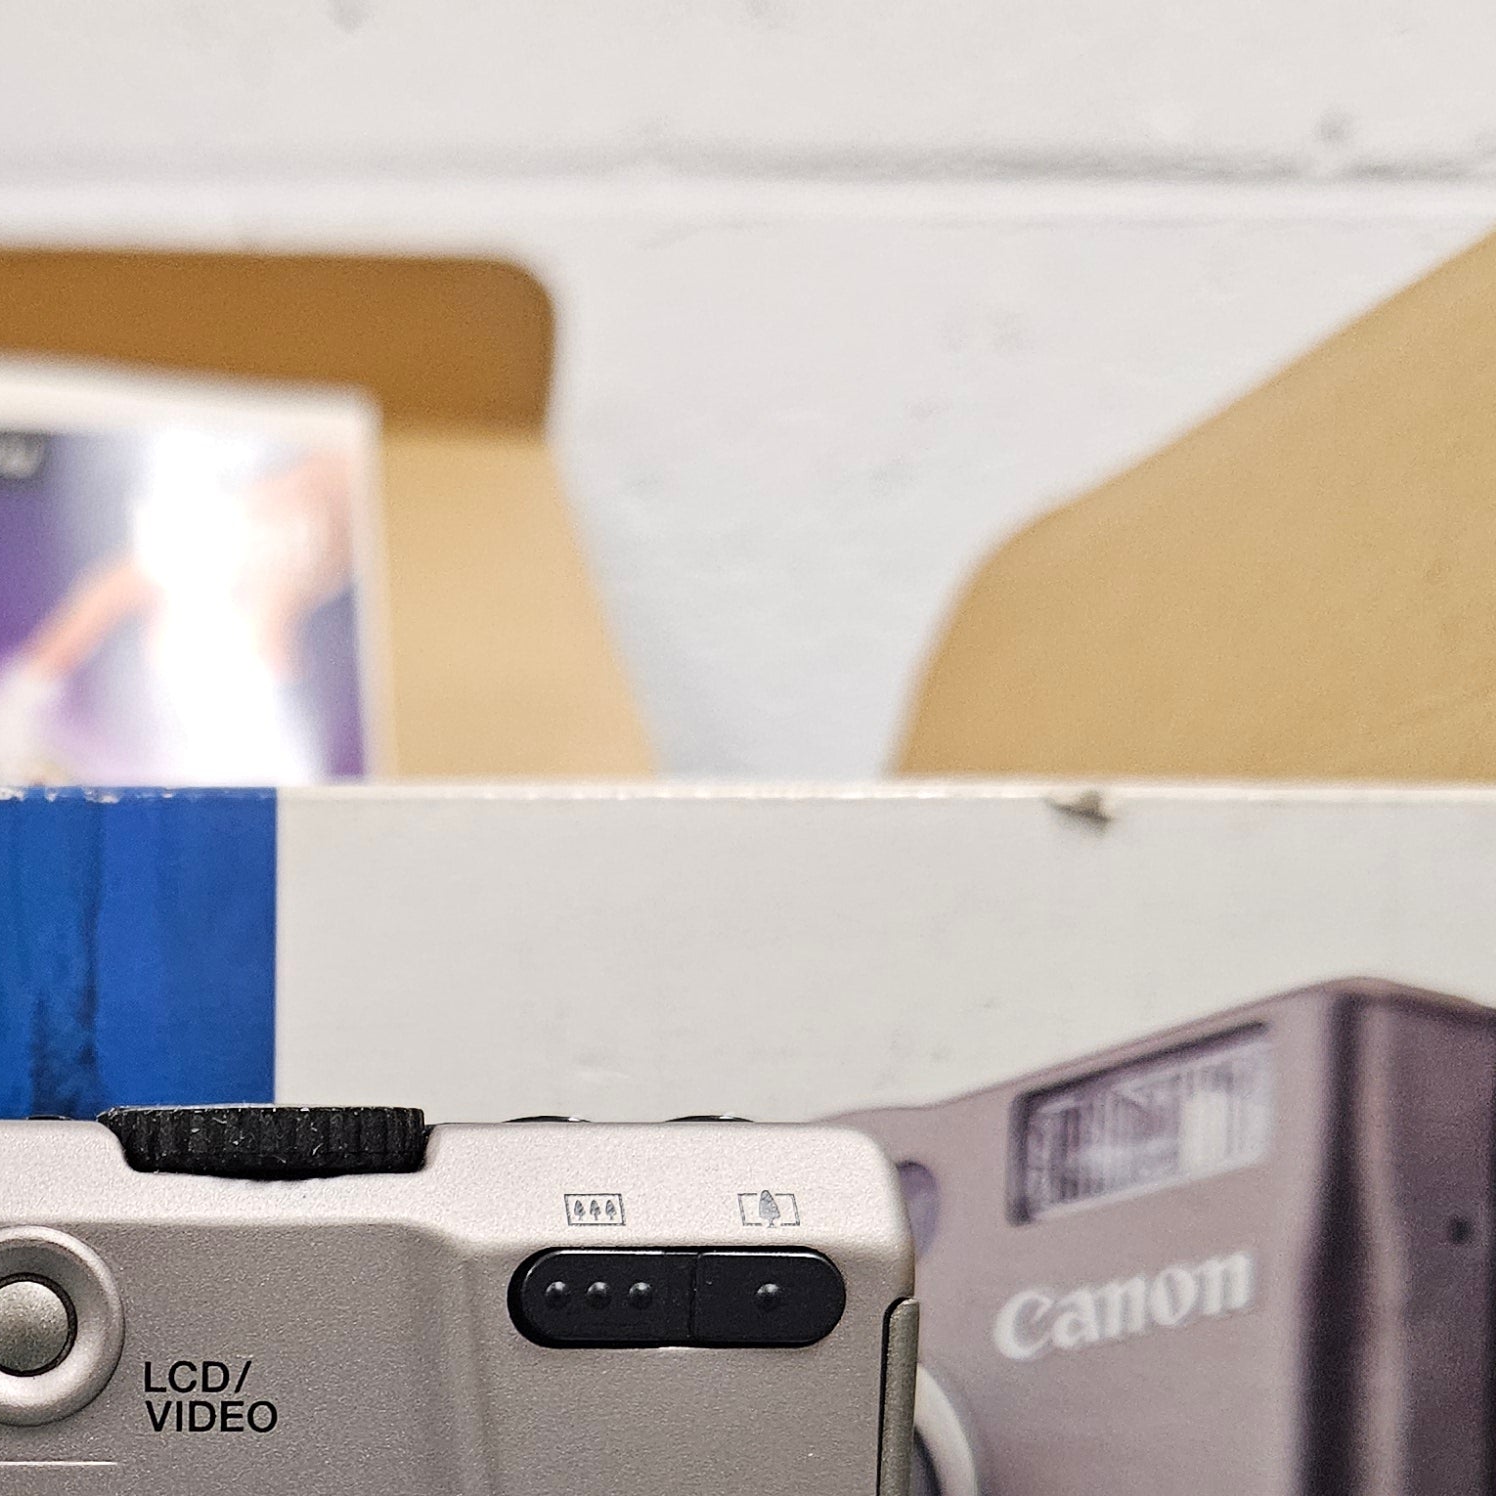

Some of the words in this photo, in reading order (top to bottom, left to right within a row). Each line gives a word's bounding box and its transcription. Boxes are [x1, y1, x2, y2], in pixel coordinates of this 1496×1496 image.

[993, 1252, 1254, 1361] Canon
[145, 1360, 252, 1393] LCD/
[145, 1400, 278, 1433] VIDEO
